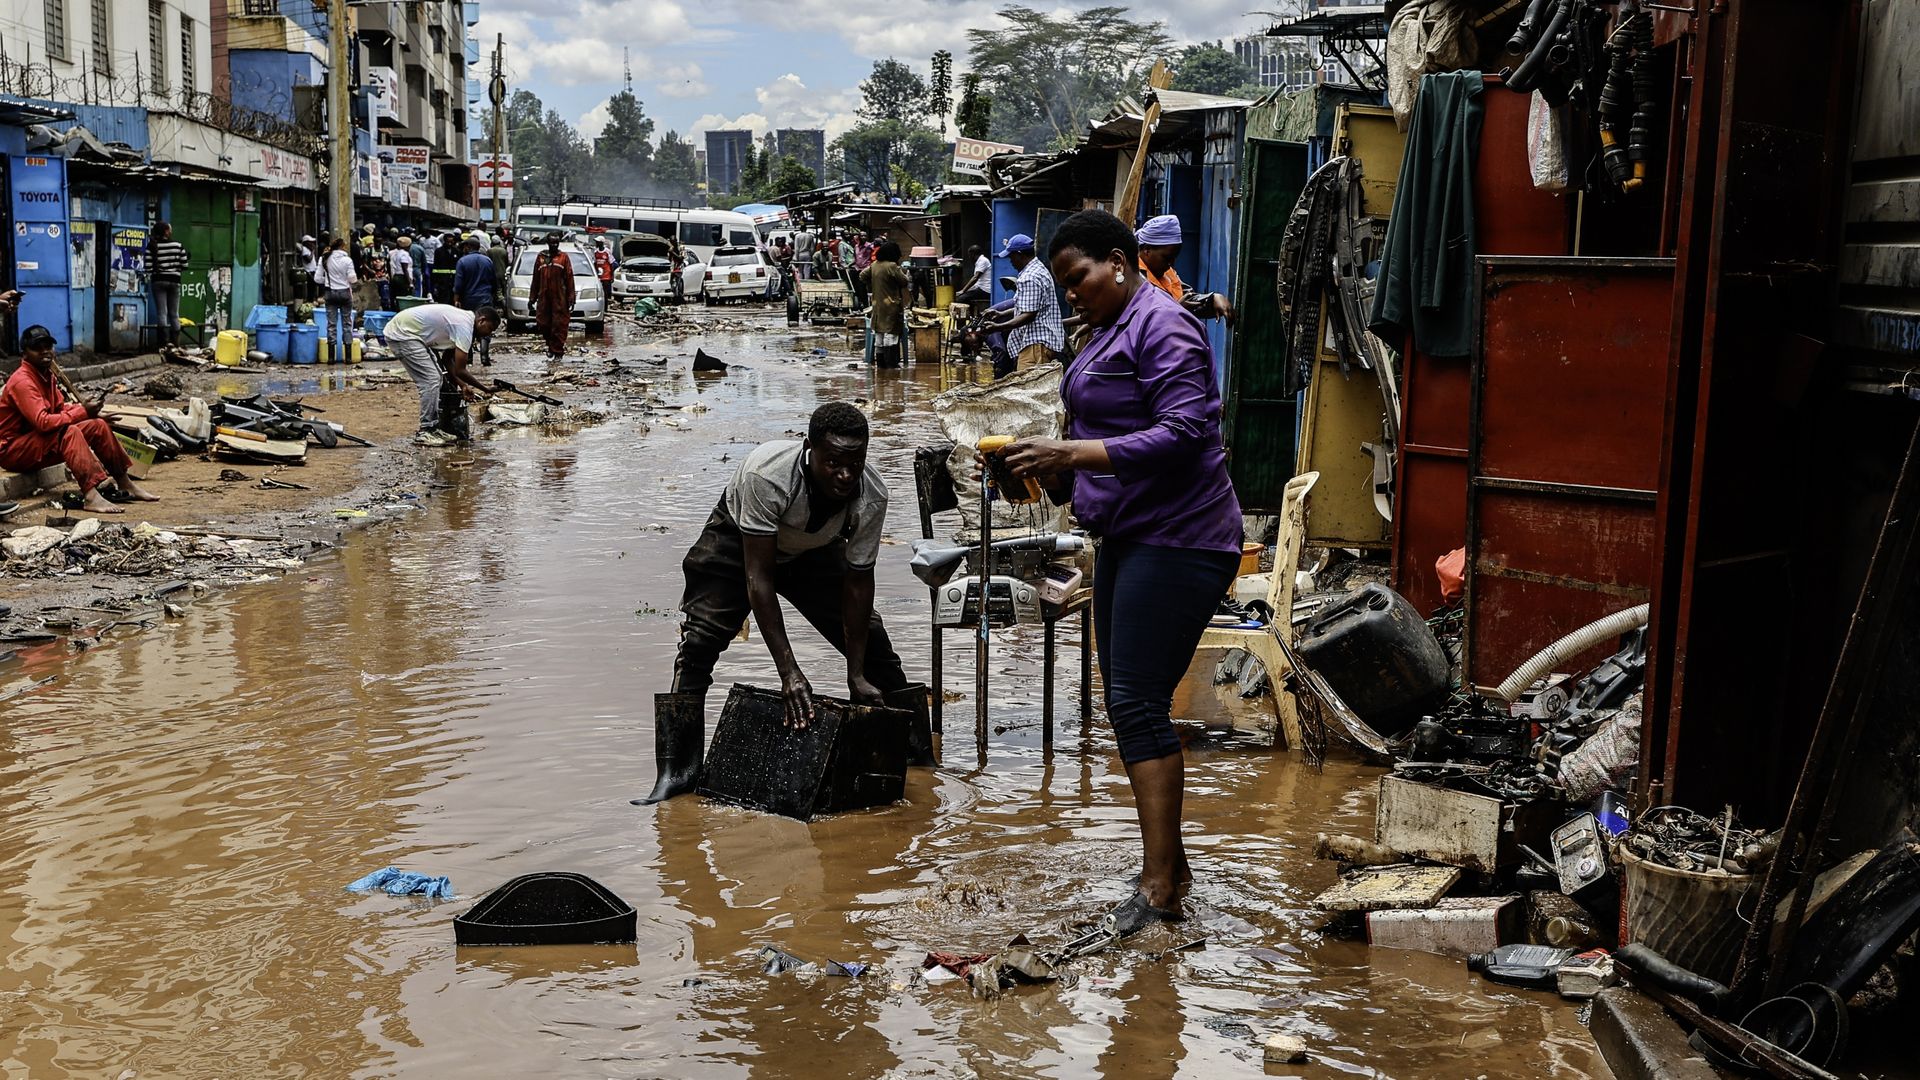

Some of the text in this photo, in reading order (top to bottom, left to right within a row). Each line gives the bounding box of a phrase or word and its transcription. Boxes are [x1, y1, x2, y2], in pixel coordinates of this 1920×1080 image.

[396, 148, 427, 156] PRADO
[955, 161, 966, 169] BUY
[19, 191, 60, 203] TOYOTA
[49, 226, 59, 234] 80
[181, 282, 207, 300] PESA
